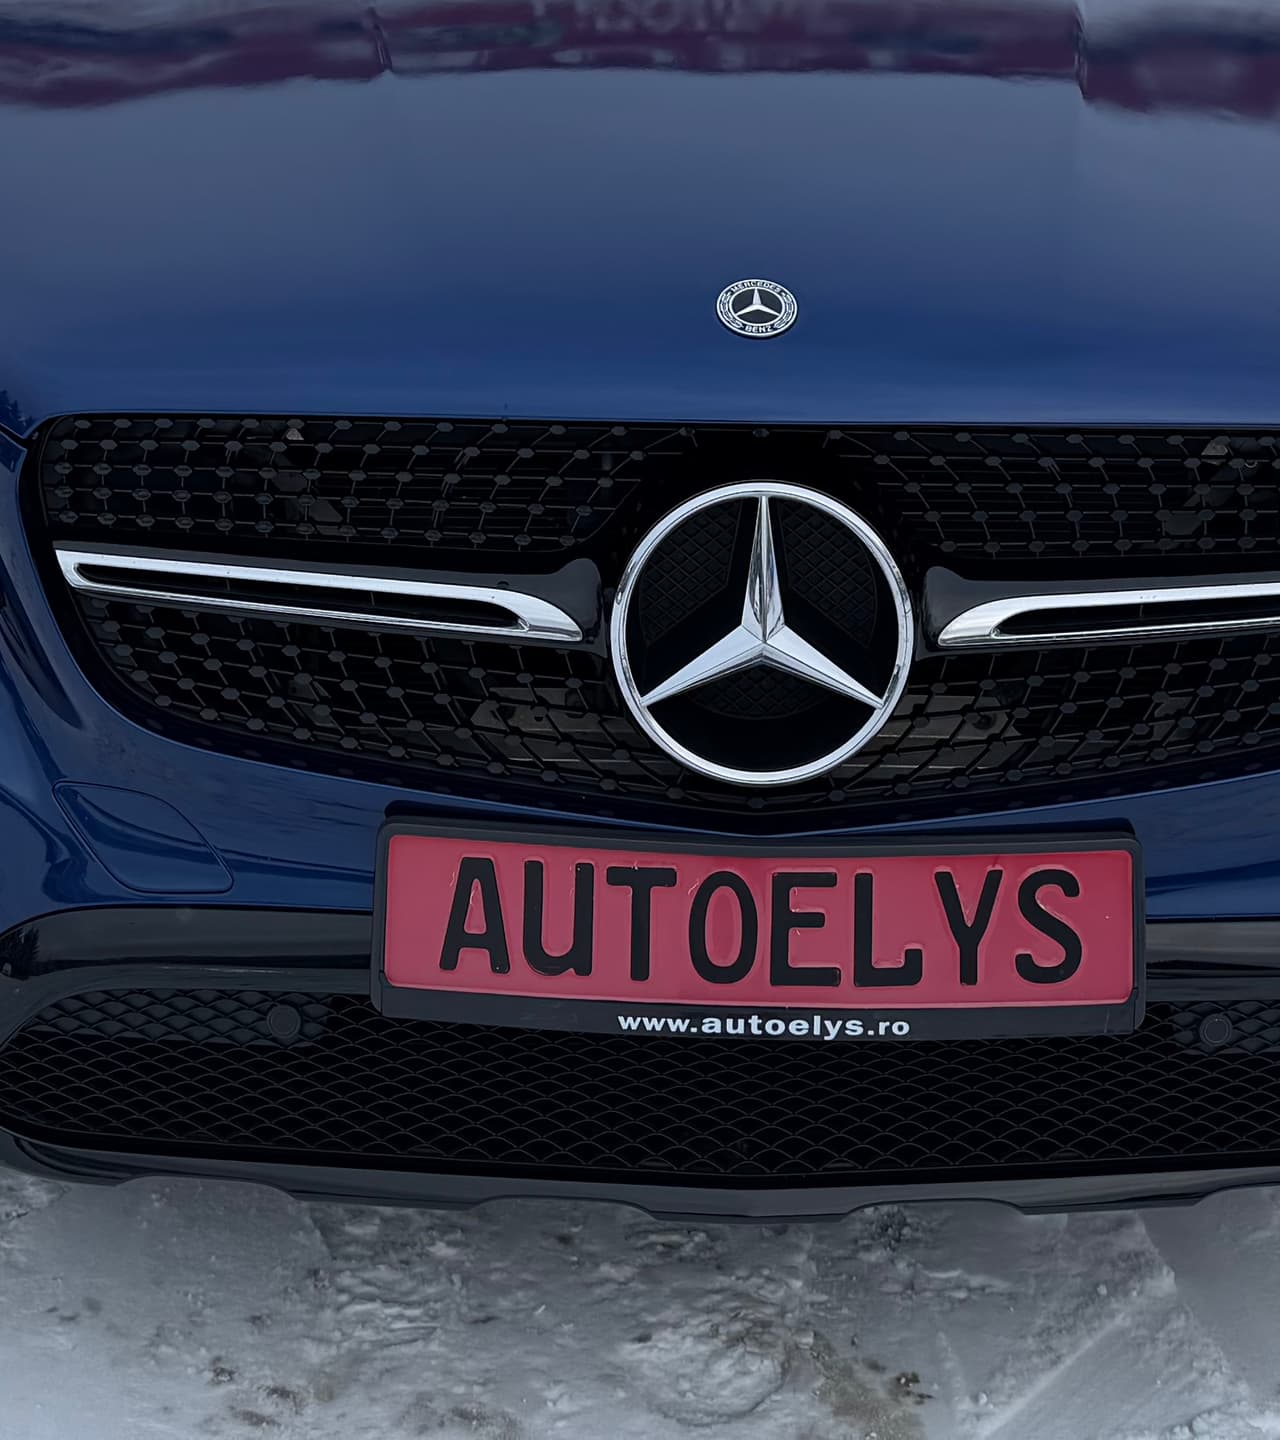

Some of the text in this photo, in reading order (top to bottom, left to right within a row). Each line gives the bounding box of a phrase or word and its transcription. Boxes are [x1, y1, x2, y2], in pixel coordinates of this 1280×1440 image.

[731, 281, 782, 293] MERCEDES
[745, 325, 773, 333] BENZ
[439, 856, 1083, 988] AUTOELYS
[617, 1014, 910, 1041] www.autoelys.ro
